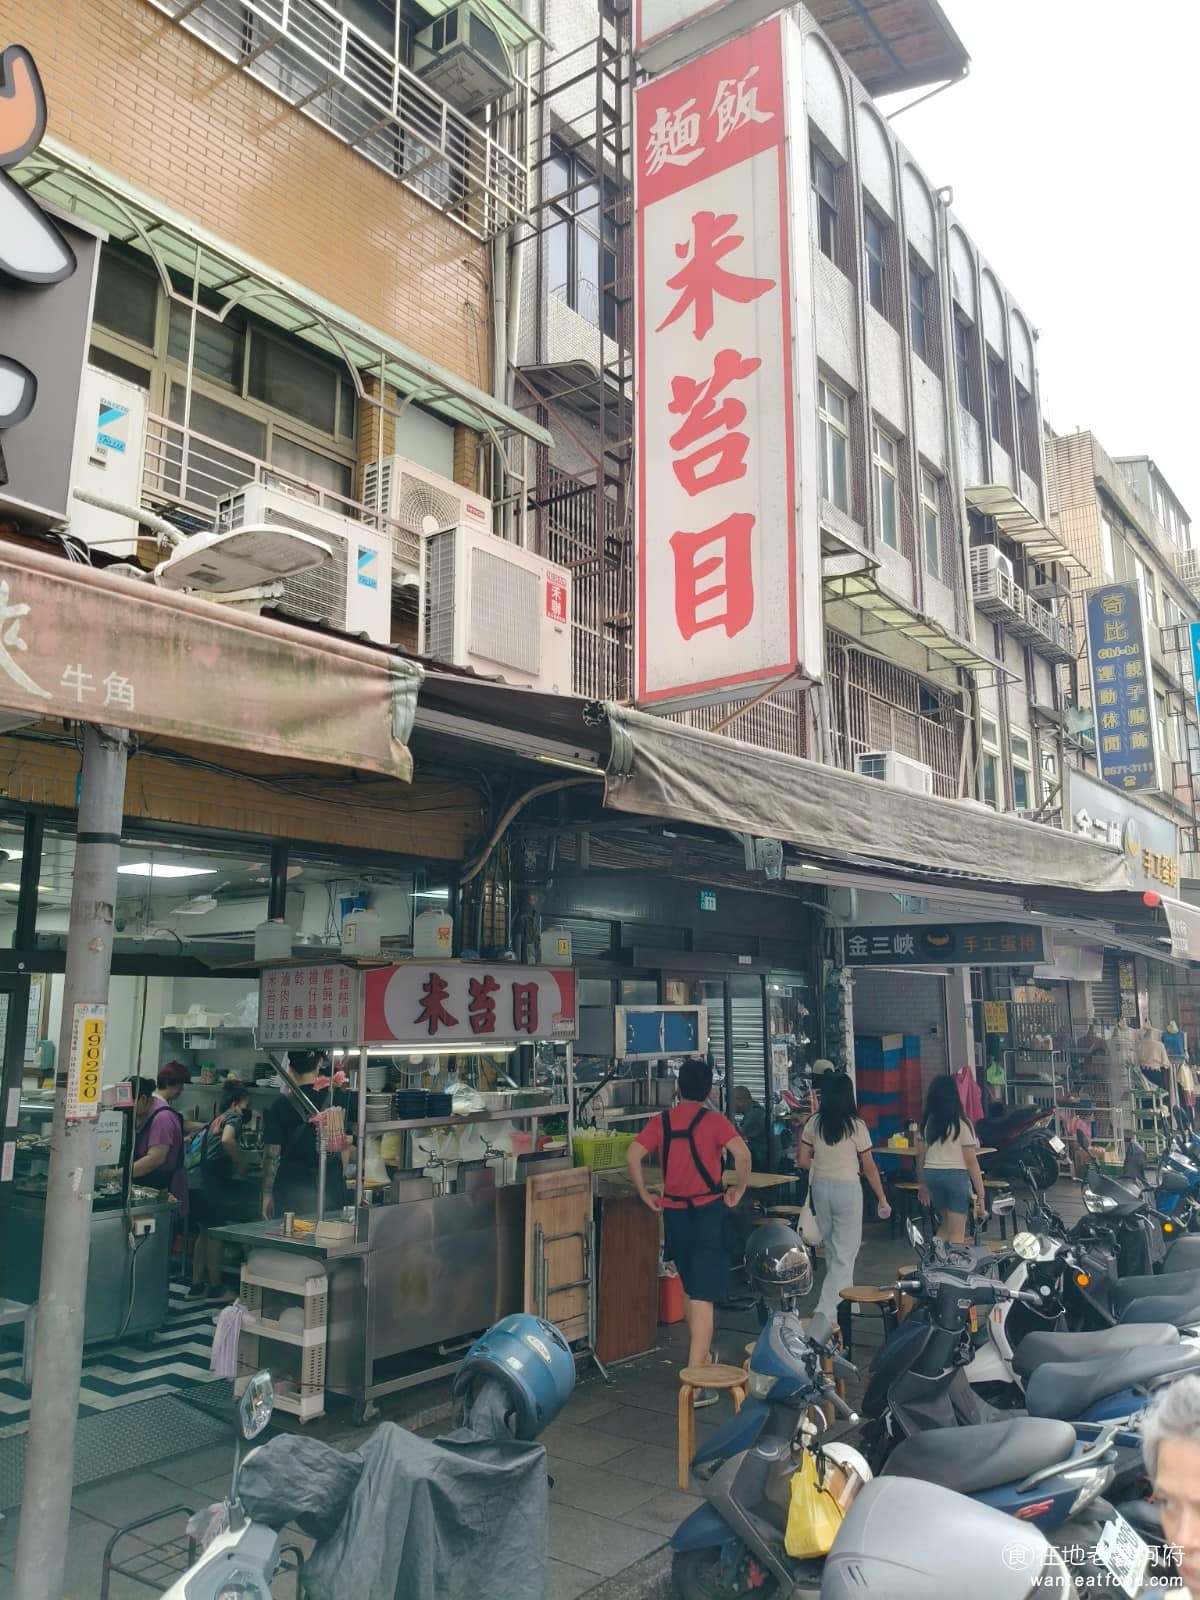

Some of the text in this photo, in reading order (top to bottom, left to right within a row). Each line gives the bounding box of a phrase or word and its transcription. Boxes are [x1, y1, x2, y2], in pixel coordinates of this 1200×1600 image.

[655, 211, 777, 642] 米苔目
[1101, 594, 1128, 642] 奇比
[60, 663, 135, 712] 牛角
[848, 933, 915, 956] 金三峽
[414, 972, 540, 1036] 米苔目
[83, 1022, 102, 1098] 190290
